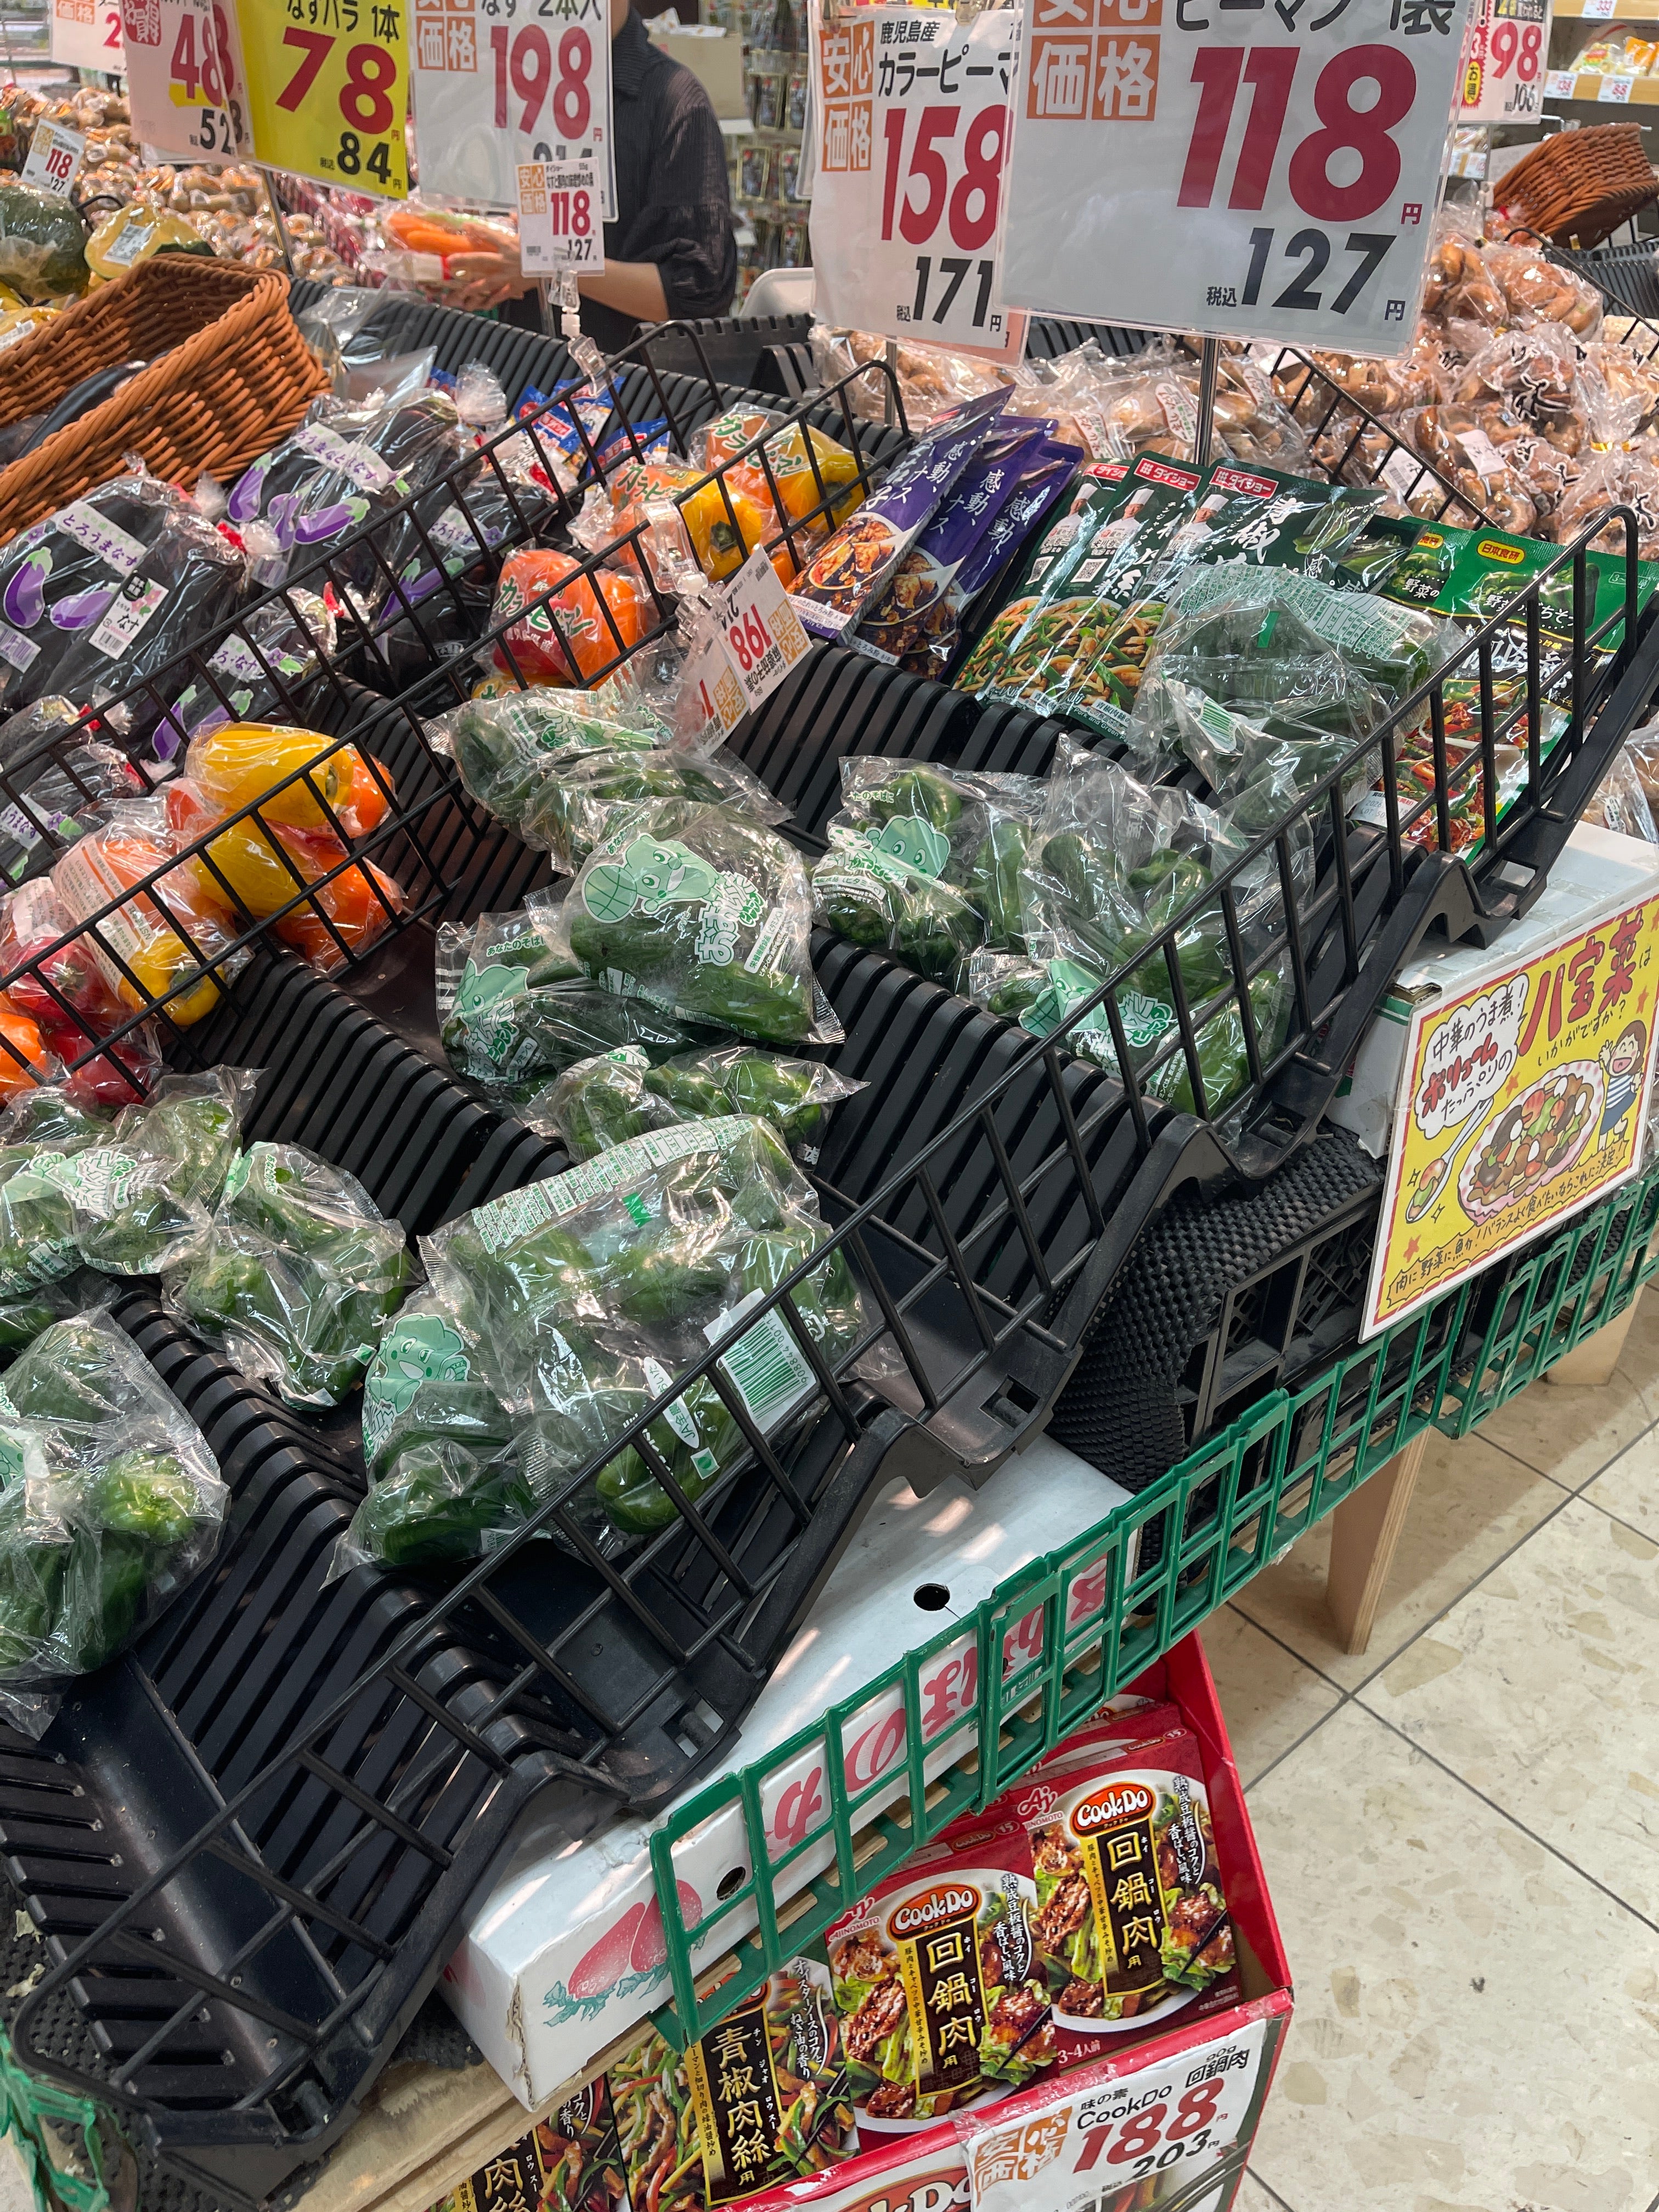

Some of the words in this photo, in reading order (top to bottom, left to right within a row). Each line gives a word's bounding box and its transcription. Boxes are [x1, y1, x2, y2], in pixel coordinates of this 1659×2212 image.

[417, 18, 476, 70] 価格
[823, 27, 873, 95] 安心
[881, 21, 939, 44] 鹿児島産
[1491, 21, 1542, 81] 98
[276, 26, 396, 134] 78
[490, 24, 591, 140] 198
[1031, 37, 1158, 119] 価格
[46, 148, 72, 178] 118
[337, 132, 392, 184] 84
[824, 105, 871, 170] 価格
[1177, 43, 1417, 222] 118
[1401, 204, 1422, 225] 円
[881, 105, 1013, 250] 158
[551, 190, 590, 236] 118
[568, 239, 592, 261] 127
[1207, 286, 1237, 308] 税込
[1241, 227, 1397, 315] 127
[1385, 300, 1406, 321] 円
[912, 256, 994, 328] 171
[1153, 467, 1194, 486] ダイショー
[1230, 474, 1271, 493] ダイショー
[1482, 544, 1521, 561] 日本食研
[1402, 578, 1440, 599] 野菜の
[729, 603, 772, 672] 198
[1074, 708, 1088, 719] Pork
[1088, 716, 1100, 725] and
[1100, 721, 1119, 737] Green
[1422, 1032, 1498, 1119] ボリューム
[1442, 1048, 1513, 1121] たっぷりの
[1168, 1824, 1193, 1884] 香ばしい風味
[830, 1916, 879, 1942] AJINOMOTO
[995, 1922, 1017, 1981] 香ばしい風味
[794, 1960, 823, 2063] オイスターソースのコクと
[791, 2013, 810, 2079] ねぎ油の香り
[1186, 2047, 1250, 2088] 回鍋肉
[1074, 2077, 1225, 2174] 188
[1081, 2087, 1128, 2109] 味の素
[1132, 2128, 1211, 2179] 203
